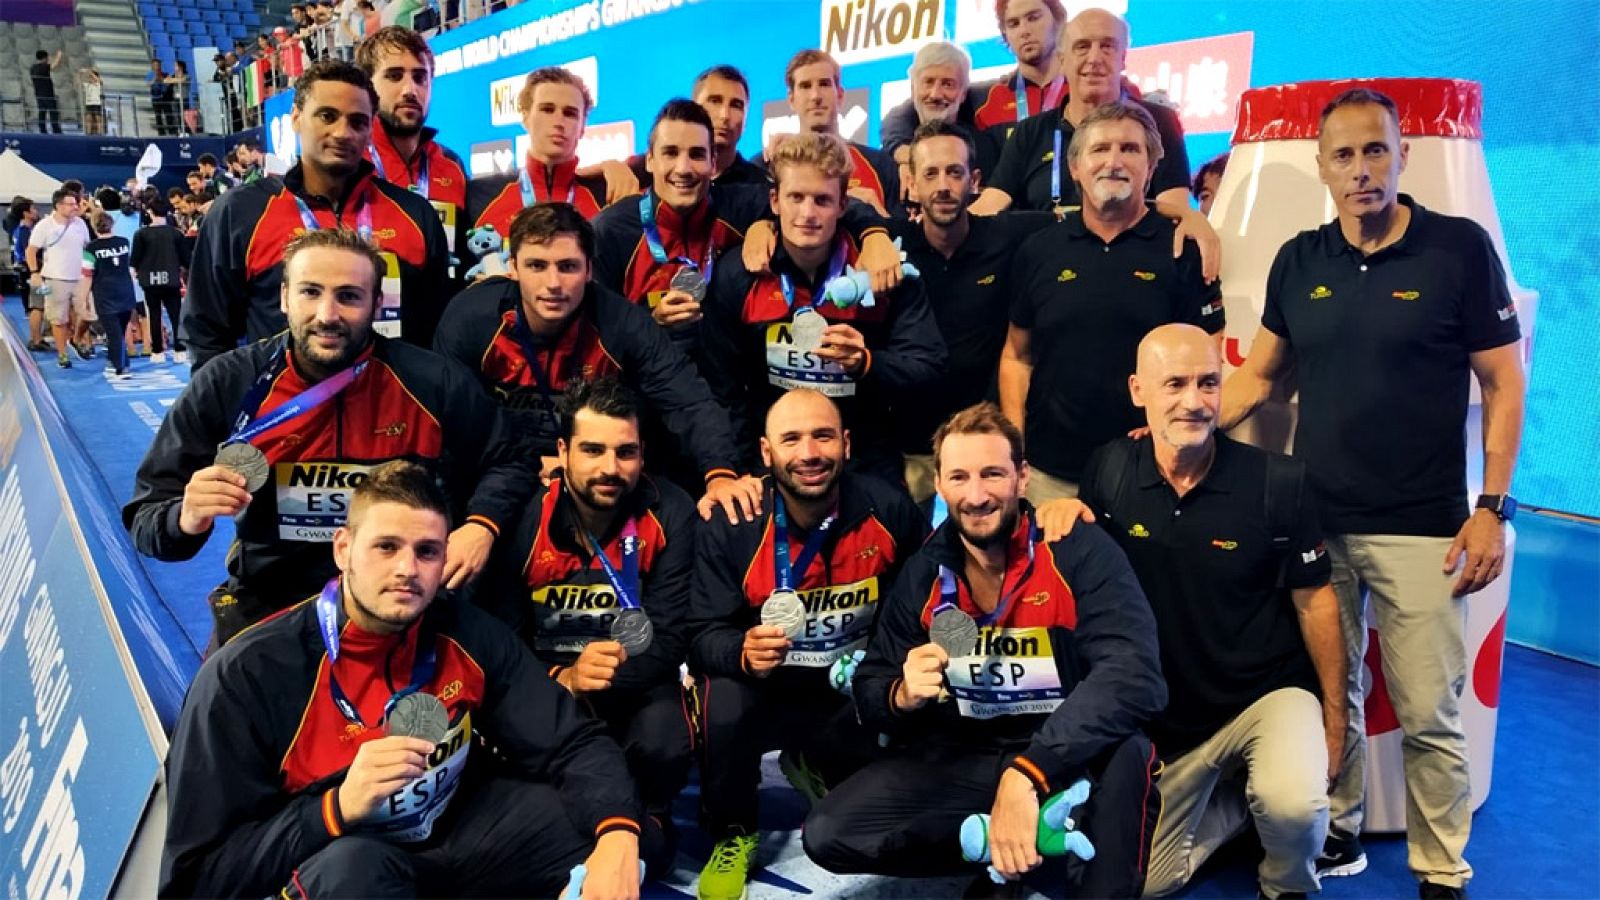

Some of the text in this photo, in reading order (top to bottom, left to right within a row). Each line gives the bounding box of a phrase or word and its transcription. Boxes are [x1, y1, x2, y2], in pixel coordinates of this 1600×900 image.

[824, 0, 940, 53] Nikon
[95, 245, 129, 259] ITALIA
[149, 271, 170, 286] HB
[289, 465, 367, 488] Niko
[307, 493, 346, 512] ES
[544, 587, 615, 610] Niko
[797, 588, 870, 614] Nikon
[805, 612, 855, 639] ESP
[974, 629, 1039, 657] ikon
[24, 583, 73, 749] GWANGJU
[968, 662, 1025, 687] ESP
[443, 679, 464, 700] ESP
[388, 766, 449, 817] ESP
